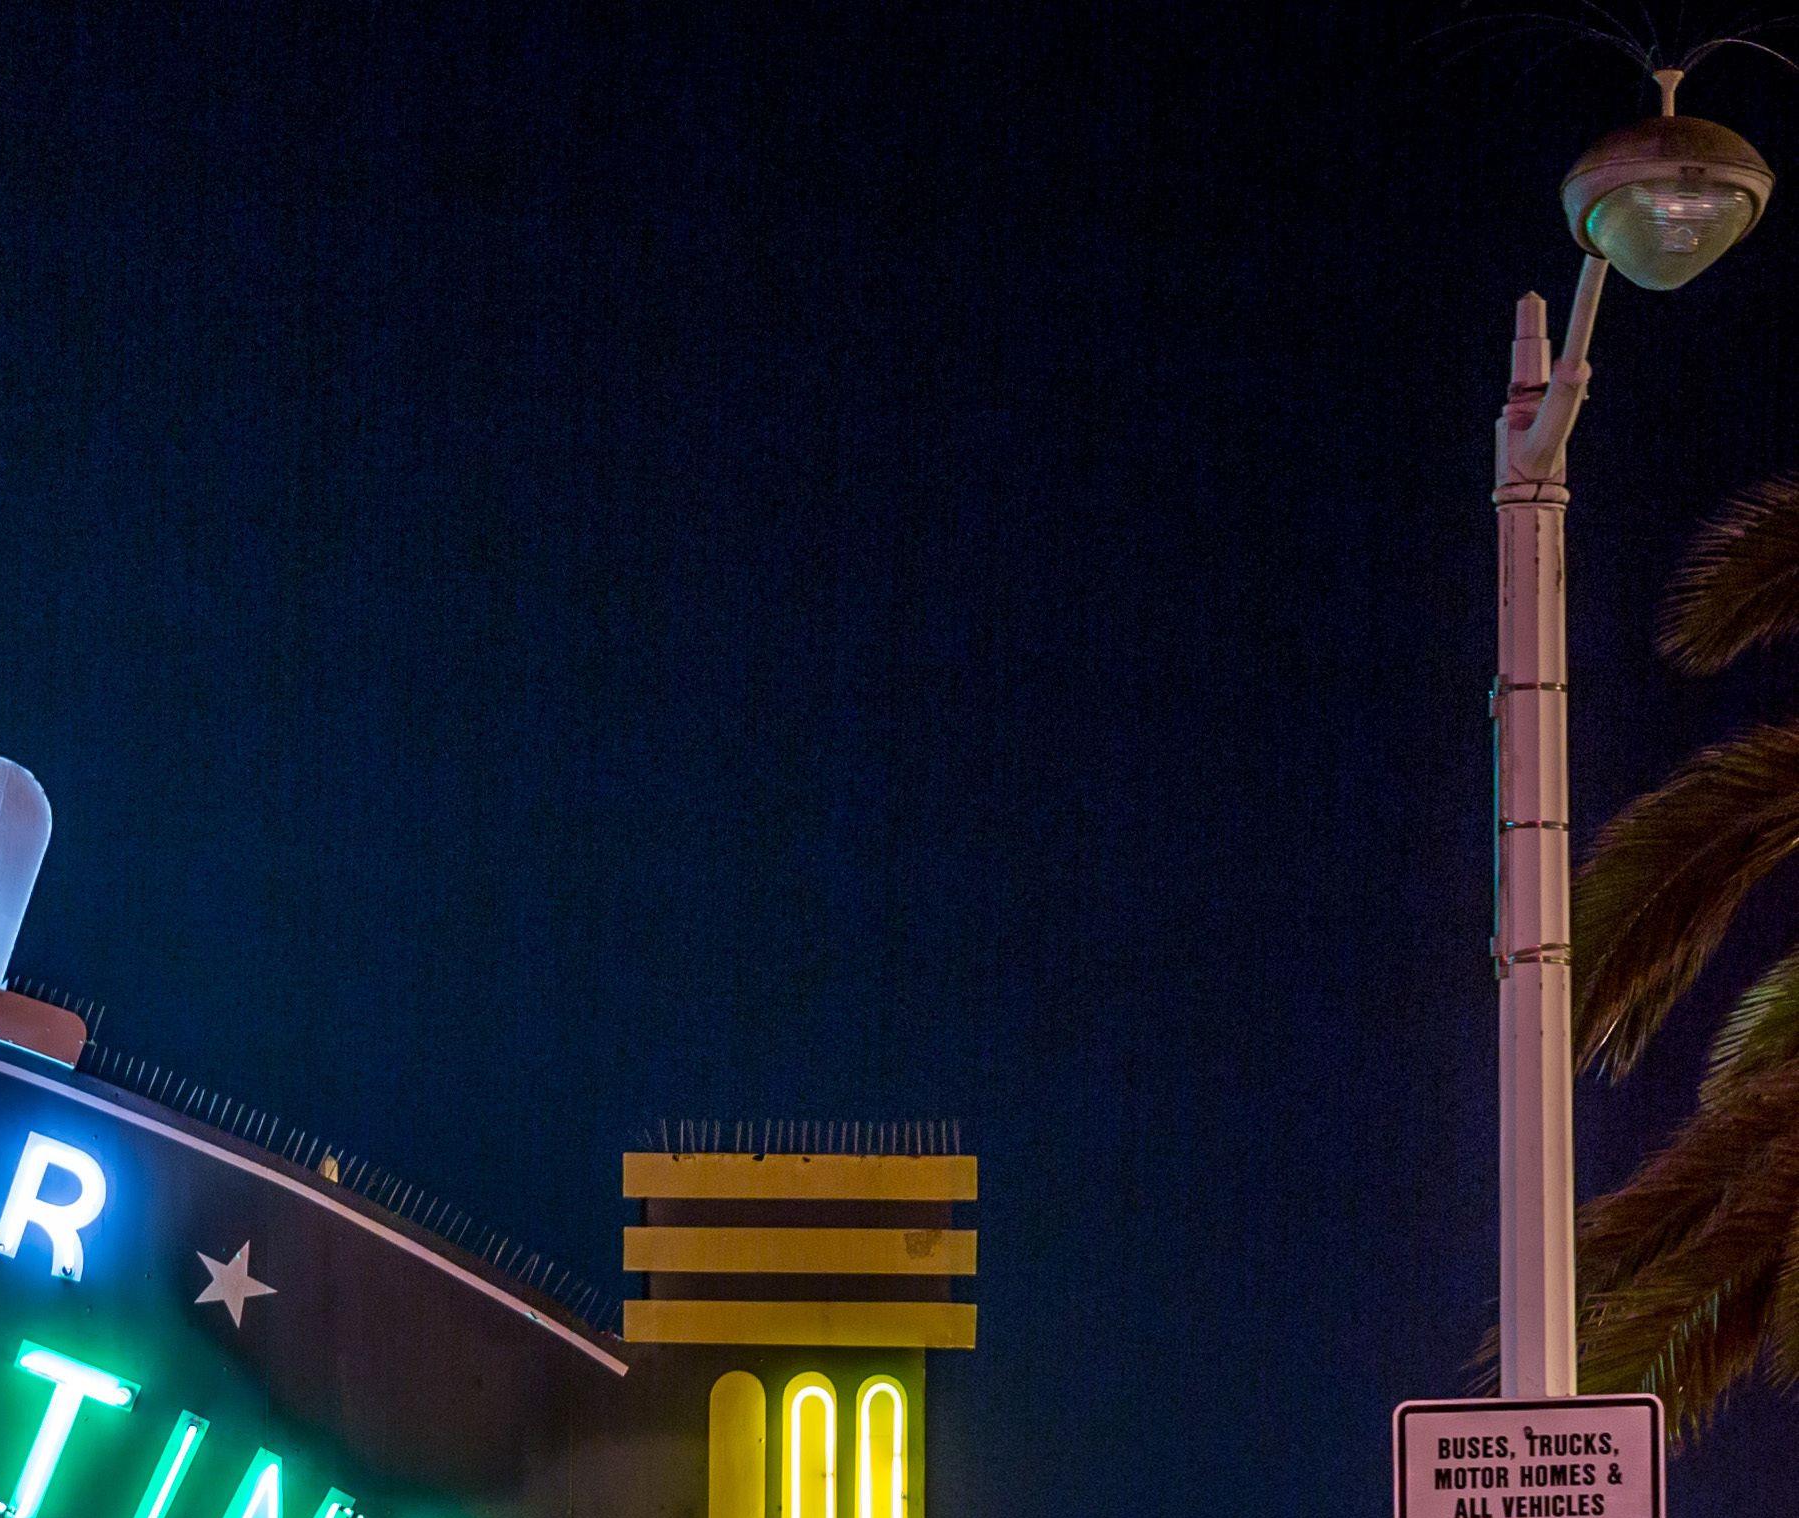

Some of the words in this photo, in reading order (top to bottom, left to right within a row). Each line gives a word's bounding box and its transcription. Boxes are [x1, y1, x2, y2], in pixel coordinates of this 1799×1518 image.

[1438, 1436, 1516, 1461] BUSES,
[1528, 1433, 1619, 1457] TRUCKS,
[1435, 1467, 1508, 1489] MOTOR
[1520, 1464, 1596, 1487] HOMES
[1608, 1464, 1623, 1484] &
[1454, 1498, 1492, 1518] ALL
[1502, 1494, 1605, 1518] VEHICLES
